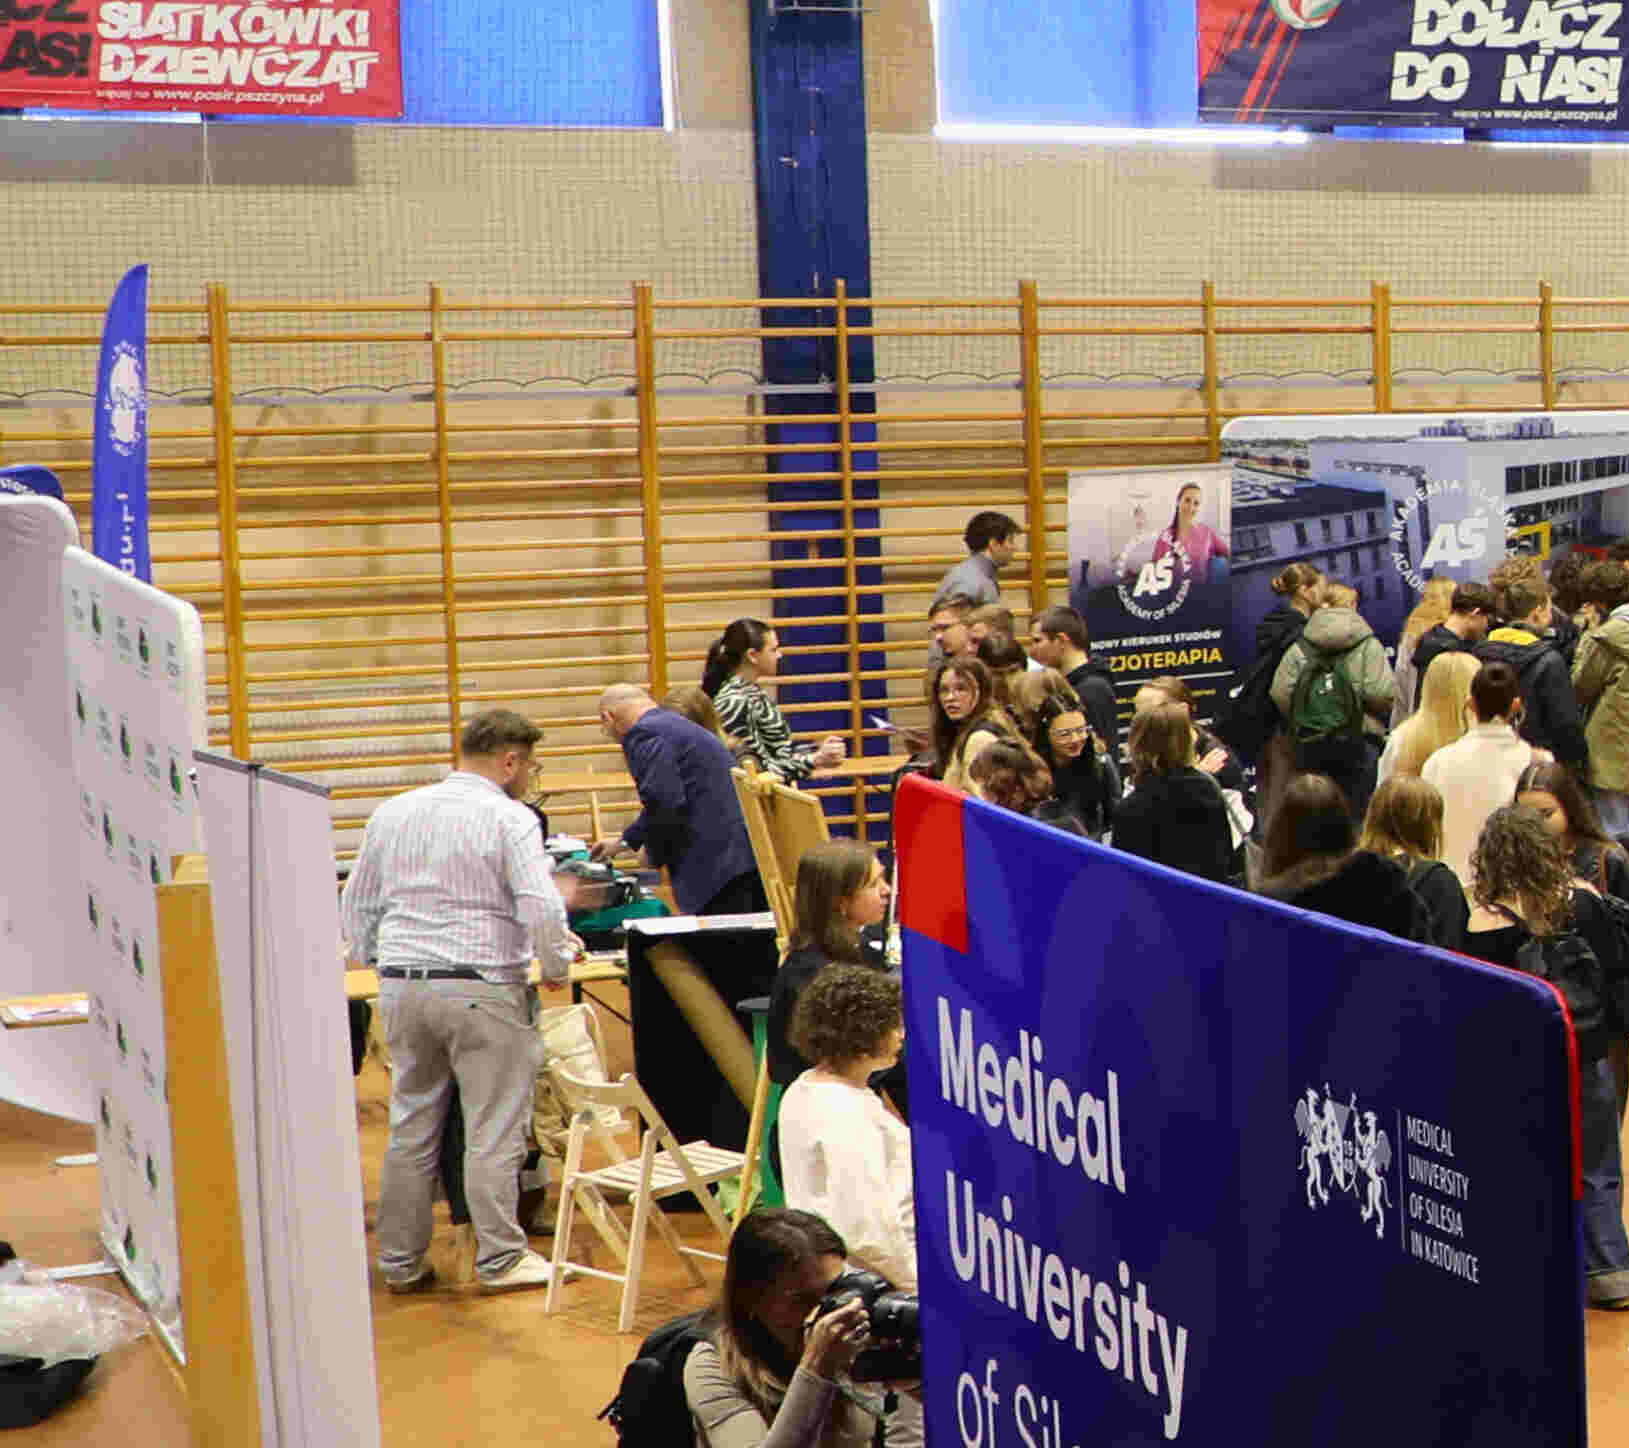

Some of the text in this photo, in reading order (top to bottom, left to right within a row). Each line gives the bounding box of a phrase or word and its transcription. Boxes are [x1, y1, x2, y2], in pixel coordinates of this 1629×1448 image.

[98, 1, 370, 47] SIATKÓWKI
[99, 43, 380, 94] DZIEWCZĄT
[1390, 51, 1623, 104] DO NAS!
[1419, 507, 1489, 569] AŚ
[937, 995, 1127, 1194] Medical
[1407, 1114, 1455, 1158] MEDICAL
[1407, 1152, 1470, 1201] UNIVERSITY
[1408, 1191, 1464, 1239] OF SILESIA
[1410, 1229, 1481, 1286] IN KATOWICE
[946, 1168, 1189, 1440] University
